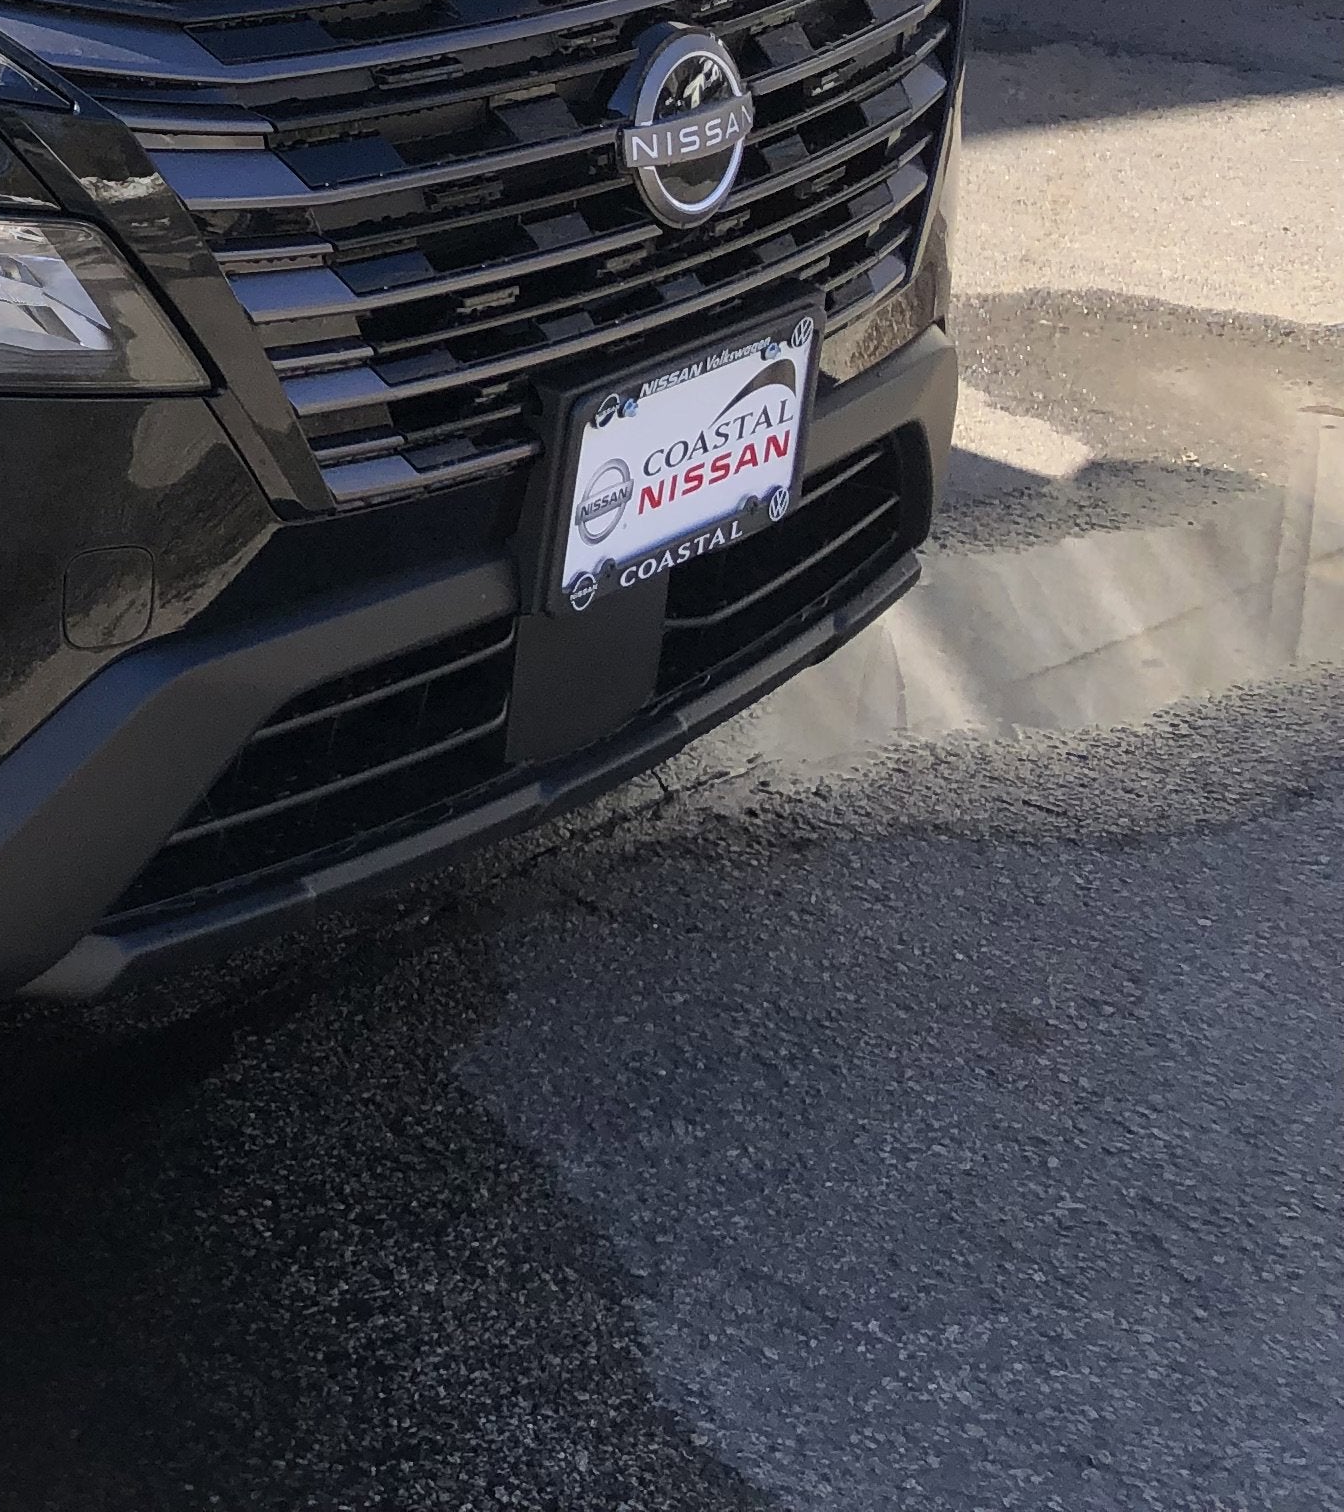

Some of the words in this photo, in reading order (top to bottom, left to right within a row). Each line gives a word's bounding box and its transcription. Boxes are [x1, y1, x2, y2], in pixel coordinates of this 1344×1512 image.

[632, 105, 752, 161] NISSAN
[640, 362, 703, 398] NISSAN
[706, 337, 771, 371] Volkswagen
[643, 399, 794, 476] COASTAL
[580, 487, 629, 517] NISSAN
[638, 429, 790, 515] NISSAN
[620, 520, 743, 587] COASTAL
